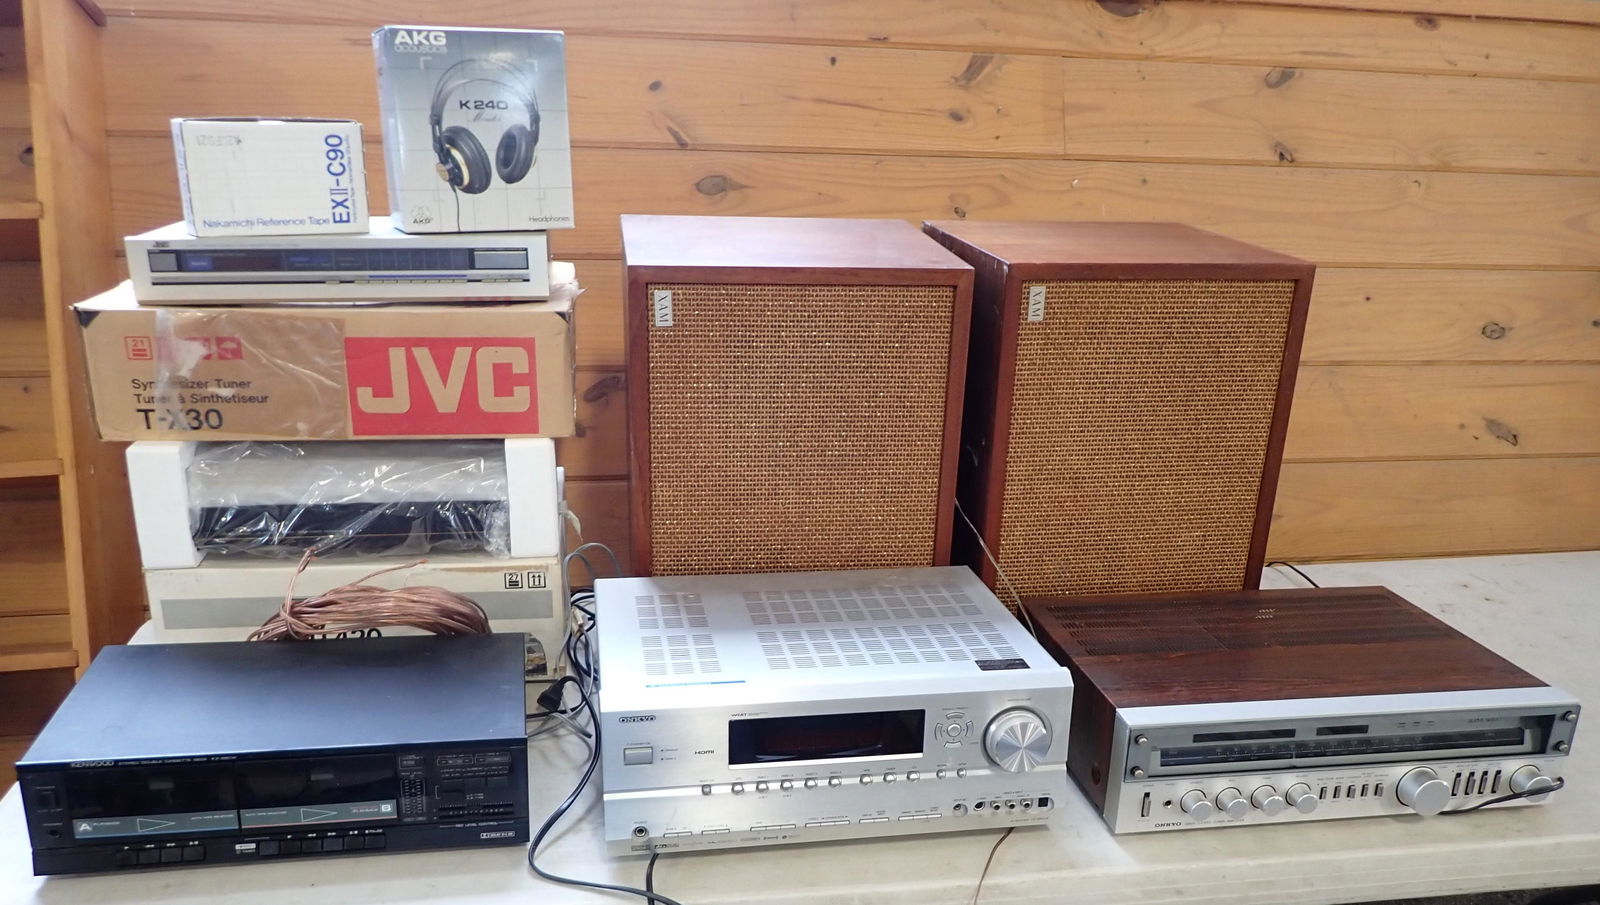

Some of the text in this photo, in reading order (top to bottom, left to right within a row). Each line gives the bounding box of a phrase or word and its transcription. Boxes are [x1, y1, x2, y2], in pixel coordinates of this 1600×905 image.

[394, 30, 447, 45] AKG
[459, 100, 508, 110] K 240
[203, 215, 330, 229] Nakamichi Reference Tape
[529, 215, 570, 224] Headphones
[132, 339, 145, 347] 21
[214, 378, 252, 389] Tuner
[356, 346, 531, 414] JVC
[190, 392, 269, 404] Sinthetiseur
[136, 408, 223, 431] T-X30
[508, 573, 520, 581] 27
[618, 714, 656, 723] ONKYO
[71, 760, 114, 768] KENWOOD
[381, 804, 391, 812] B
[79, 823, 92, 832] A
